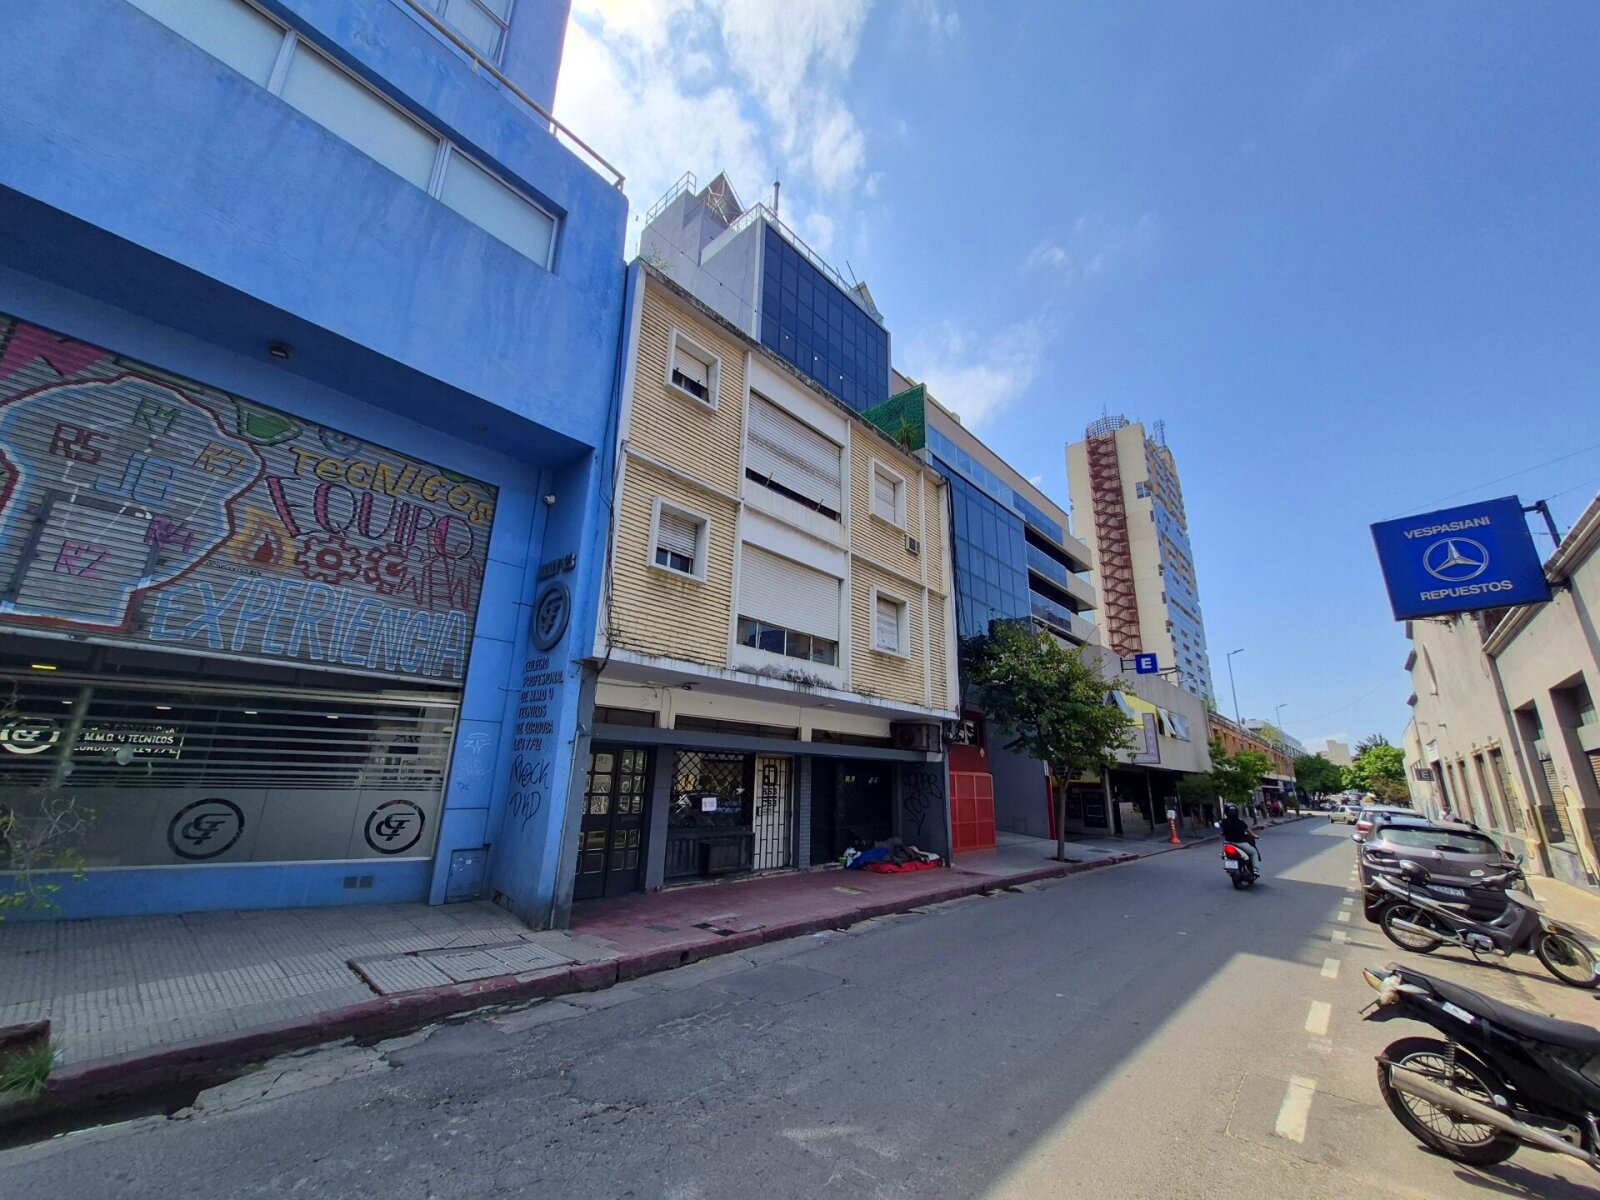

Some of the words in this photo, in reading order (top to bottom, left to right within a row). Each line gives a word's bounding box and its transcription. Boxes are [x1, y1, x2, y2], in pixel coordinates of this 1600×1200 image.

[50, 422, 111, 465] R5
[264, 475, 474, 560] EQUIPO
[1404, 516, 1490, 540] VESPASIANI
[1420, 580, 1513, 601] REPUESTOS
[149, 575, 468, 679] EXPERIENCIA
[1140, 657, 1153, 670] E
[522, 670, 564, 688] PROFESIONAL
[128, 734, 175, 745] TECNICOS
